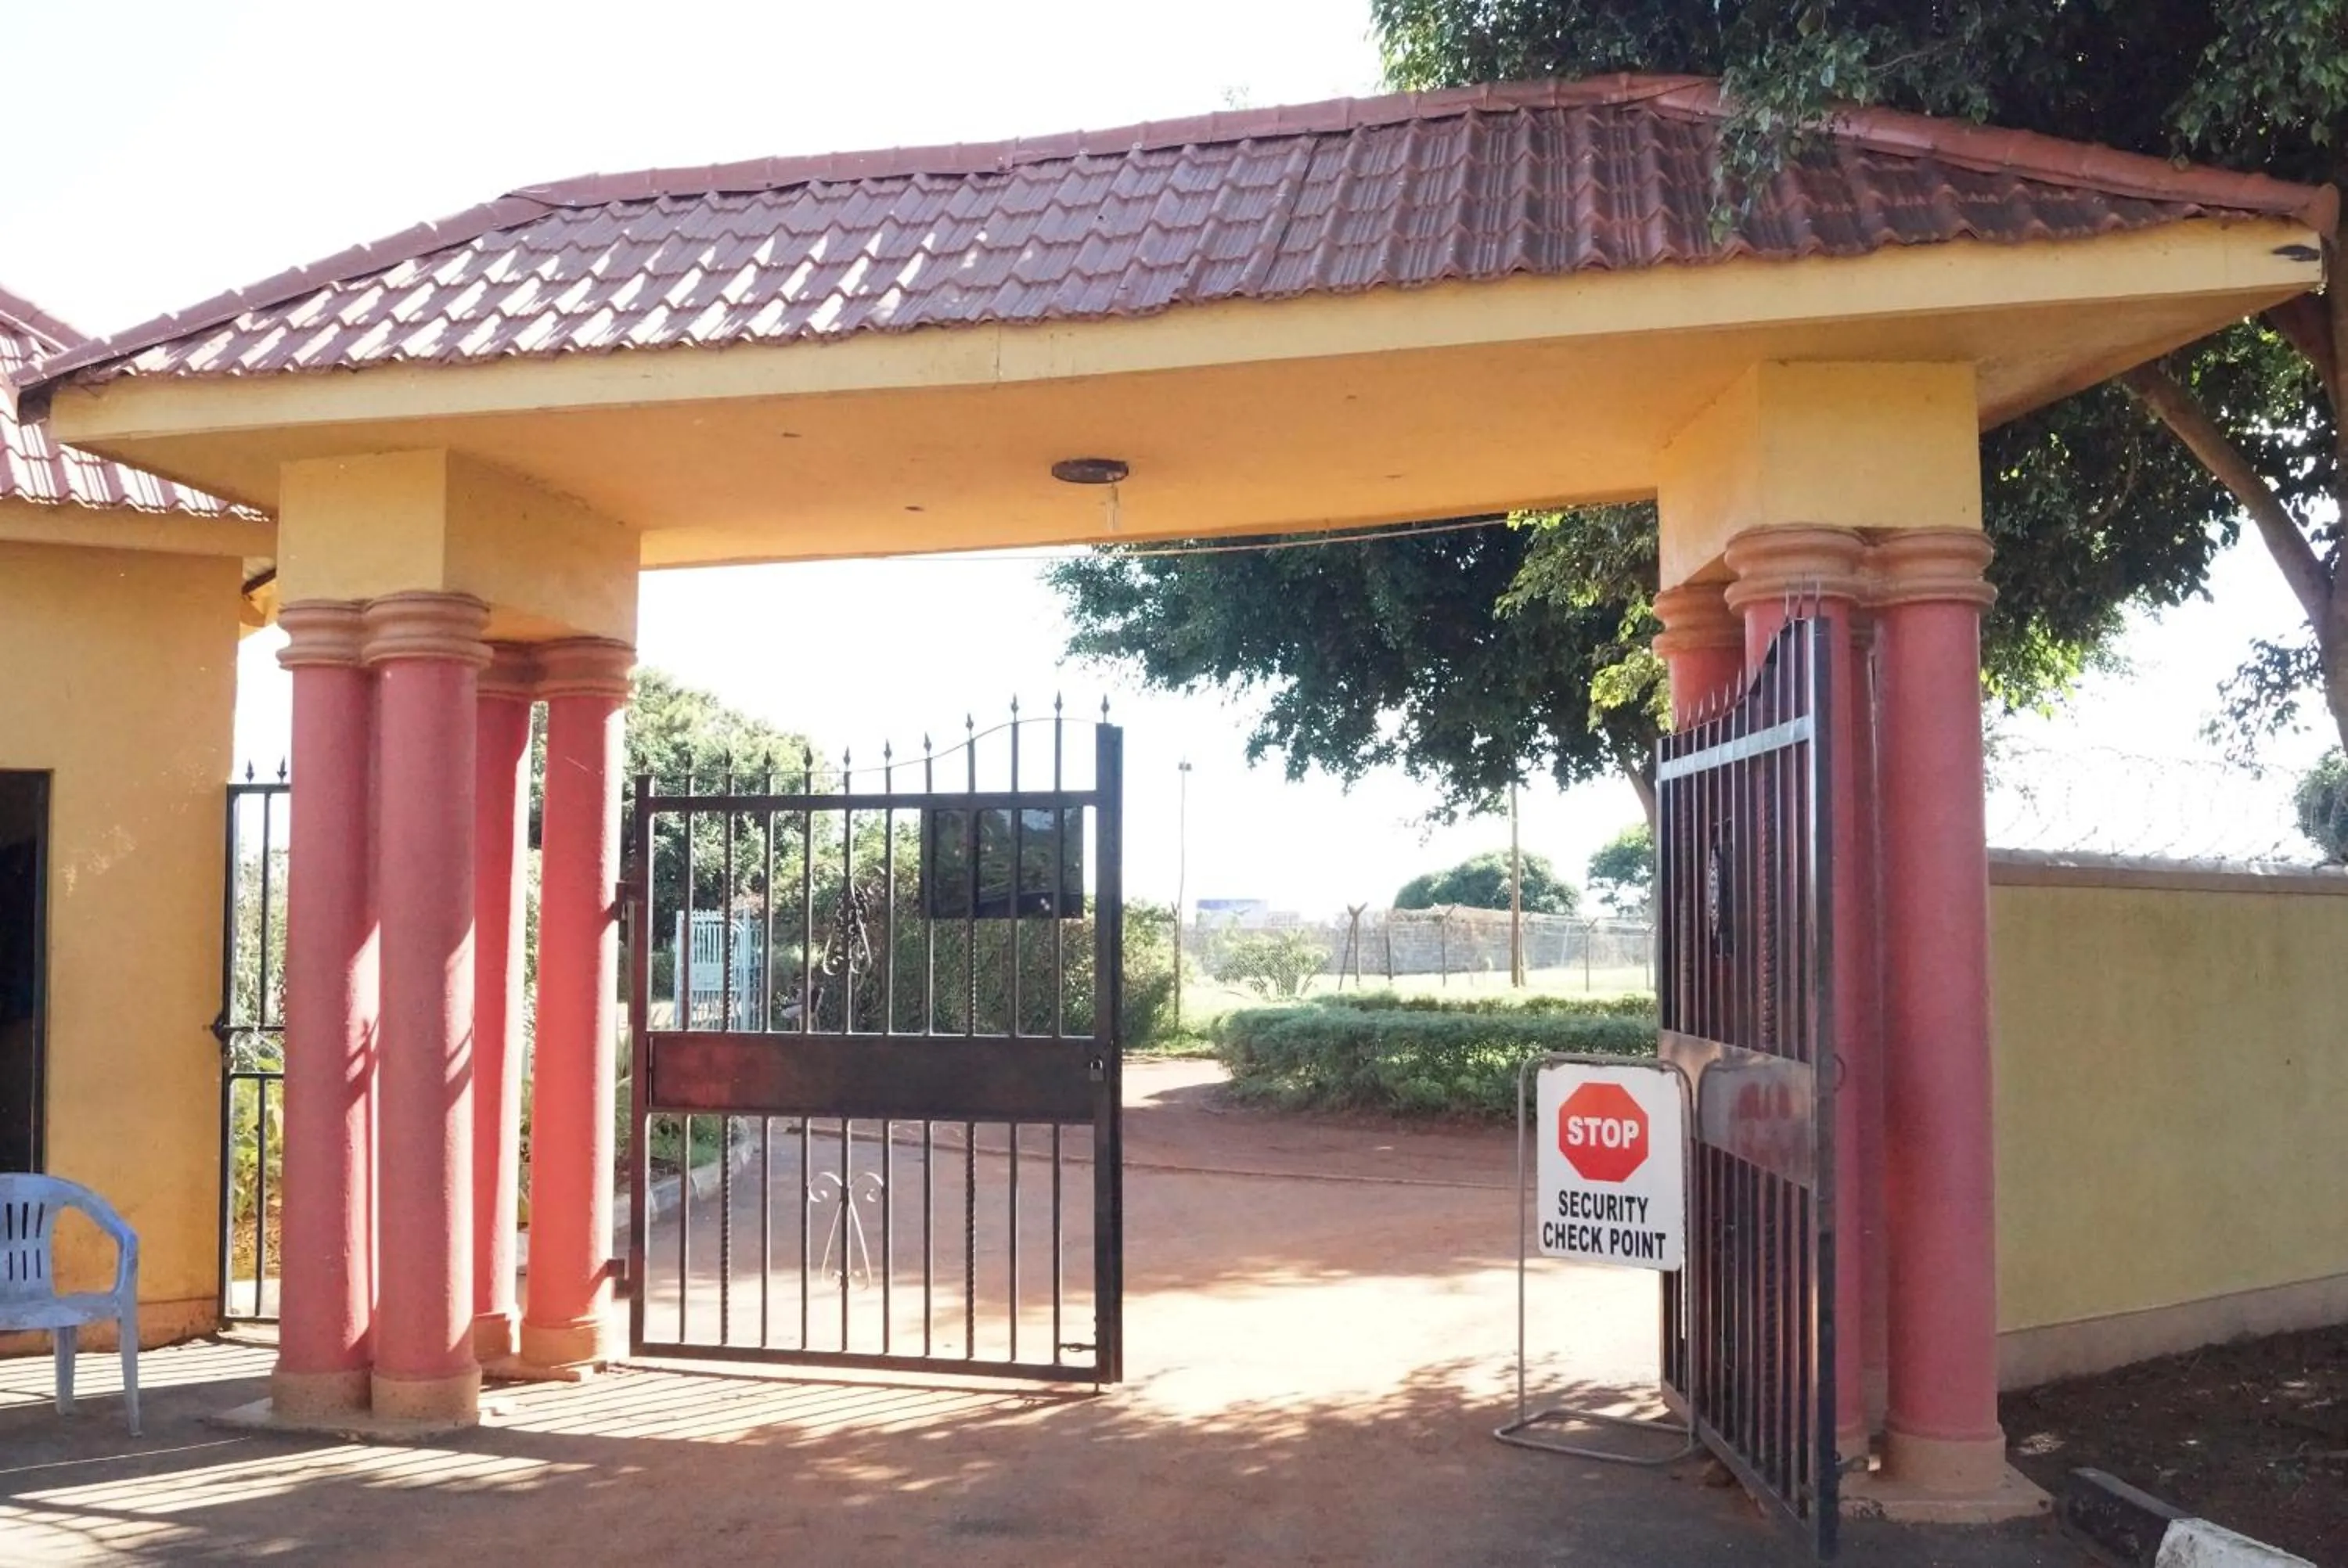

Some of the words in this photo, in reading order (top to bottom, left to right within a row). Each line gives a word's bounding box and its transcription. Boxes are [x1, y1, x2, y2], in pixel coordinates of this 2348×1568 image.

[1567, 1116, 1640, 1149] STOP
[1558, 1190, 1649, 1224] SECURITY
[1543, 1221, 1603, 1253] CHECK
[1610, 1228, 1666, 1260] POINT
